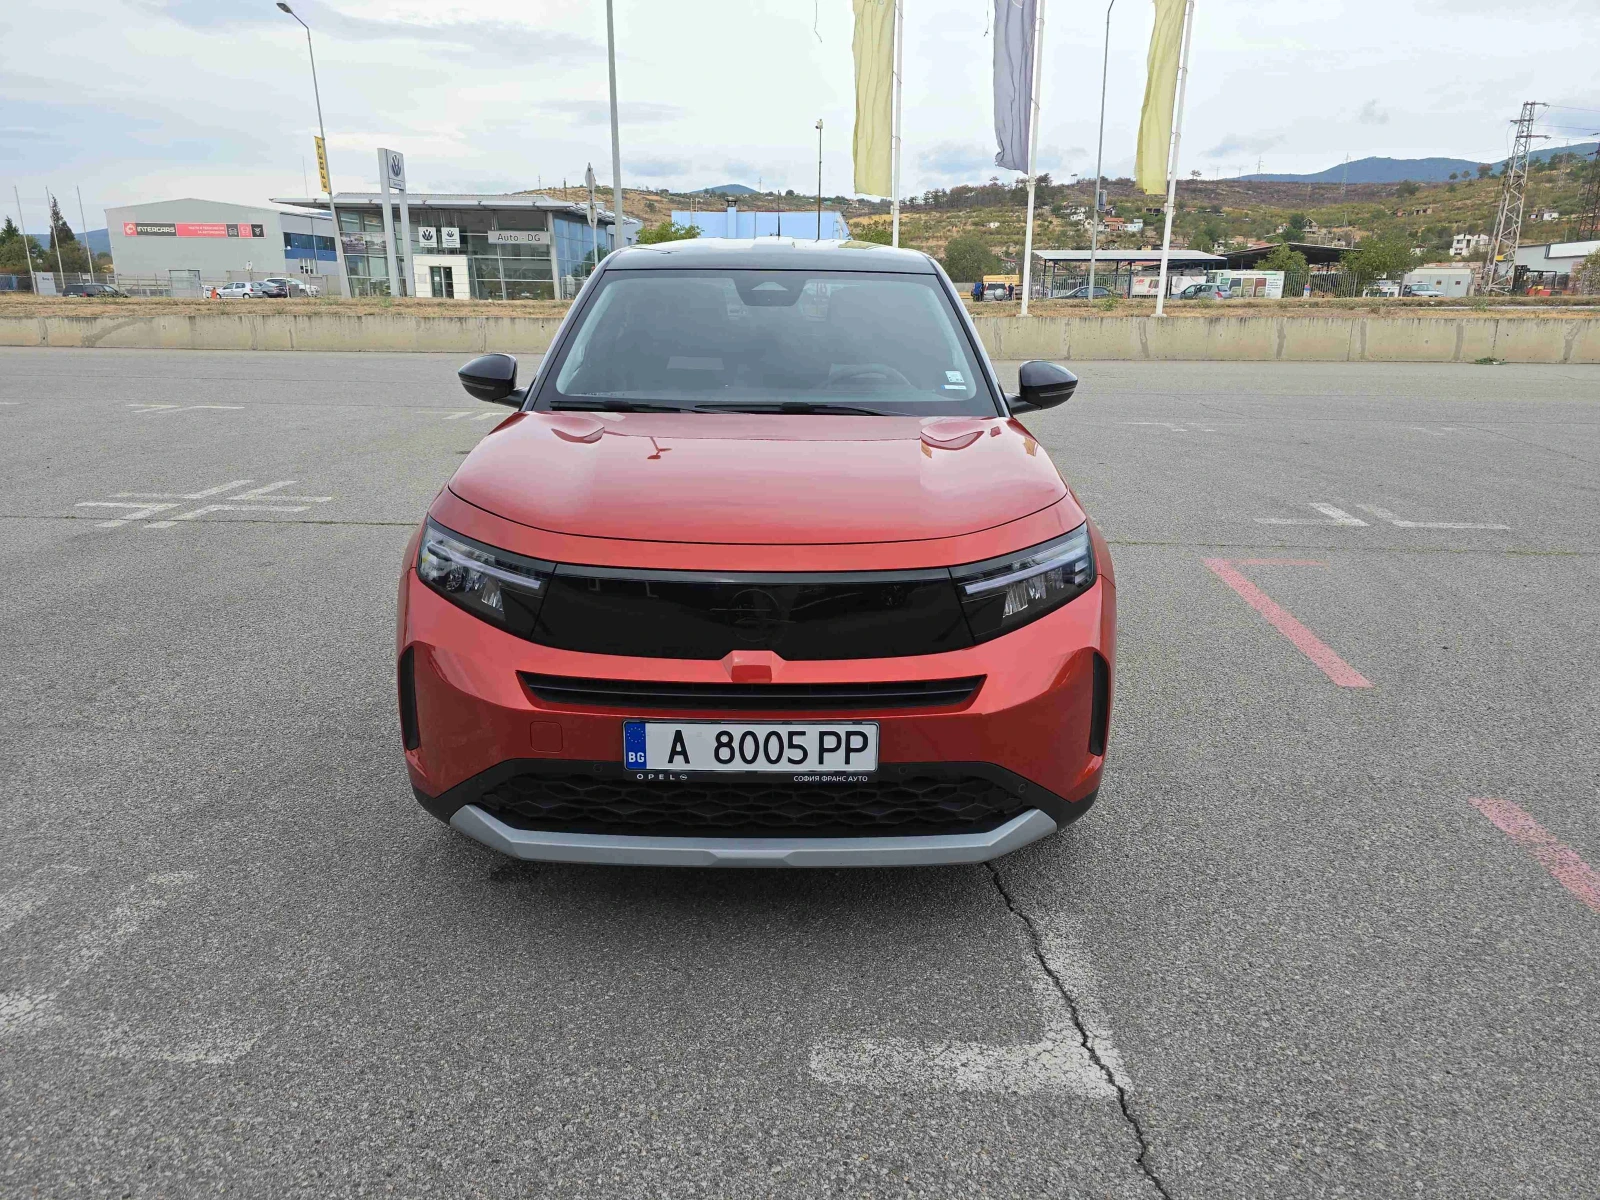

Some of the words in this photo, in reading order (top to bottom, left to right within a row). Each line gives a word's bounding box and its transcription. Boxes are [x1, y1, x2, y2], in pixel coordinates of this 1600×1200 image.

[497, 233, 519, 242] Auto
[527, 233, 541, 242] DG
[667, 729, 691, 765] A
[628, 751, 645, 763] BG
[636, 773, 676, 781] OPEL
